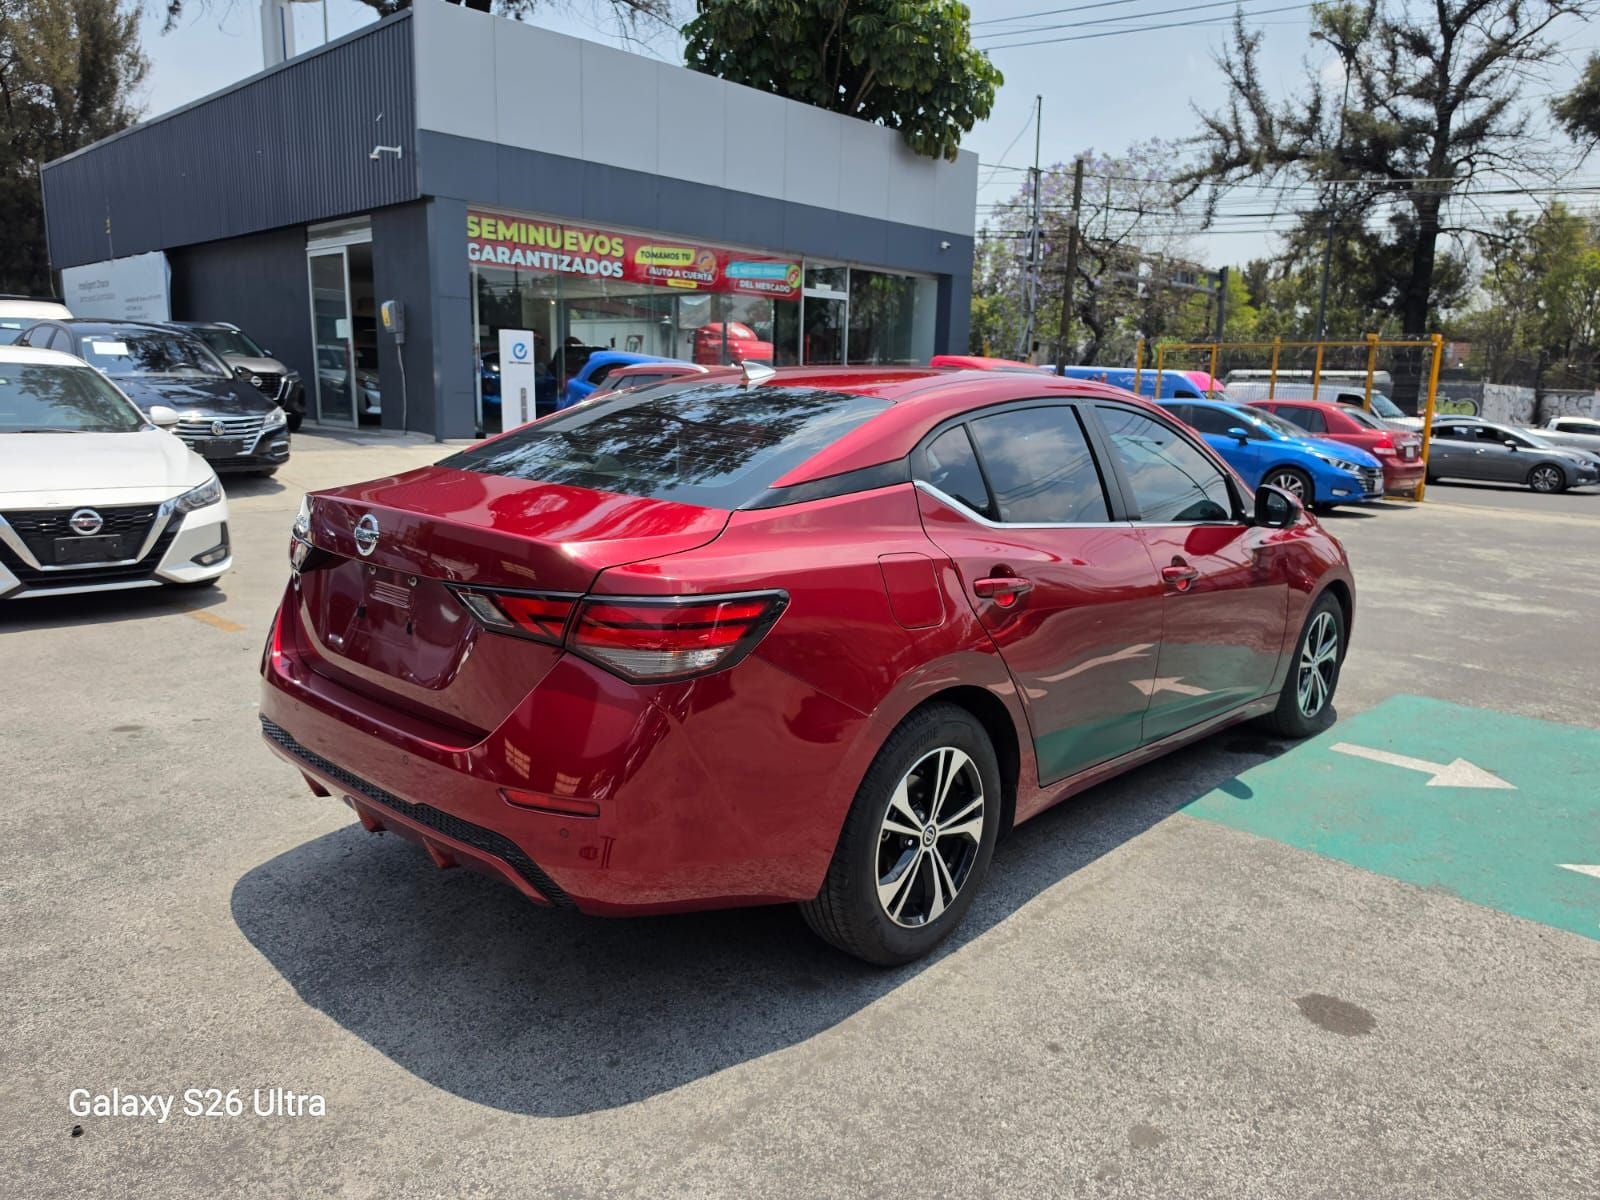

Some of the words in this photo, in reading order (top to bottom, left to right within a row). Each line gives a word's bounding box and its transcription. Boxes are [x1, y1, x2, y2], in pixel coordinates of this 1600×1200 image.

[467, 215, 625, 258] SEMINUEVOS
[467, 242, 624, 278] GARANTIZADOS
[640, 250, 680, 261] TOMAMOS
[681, 253, 692, 262] TU
[649, 266, 674, 277] AUTO
[682, 271, 713, 281] CUENTA
